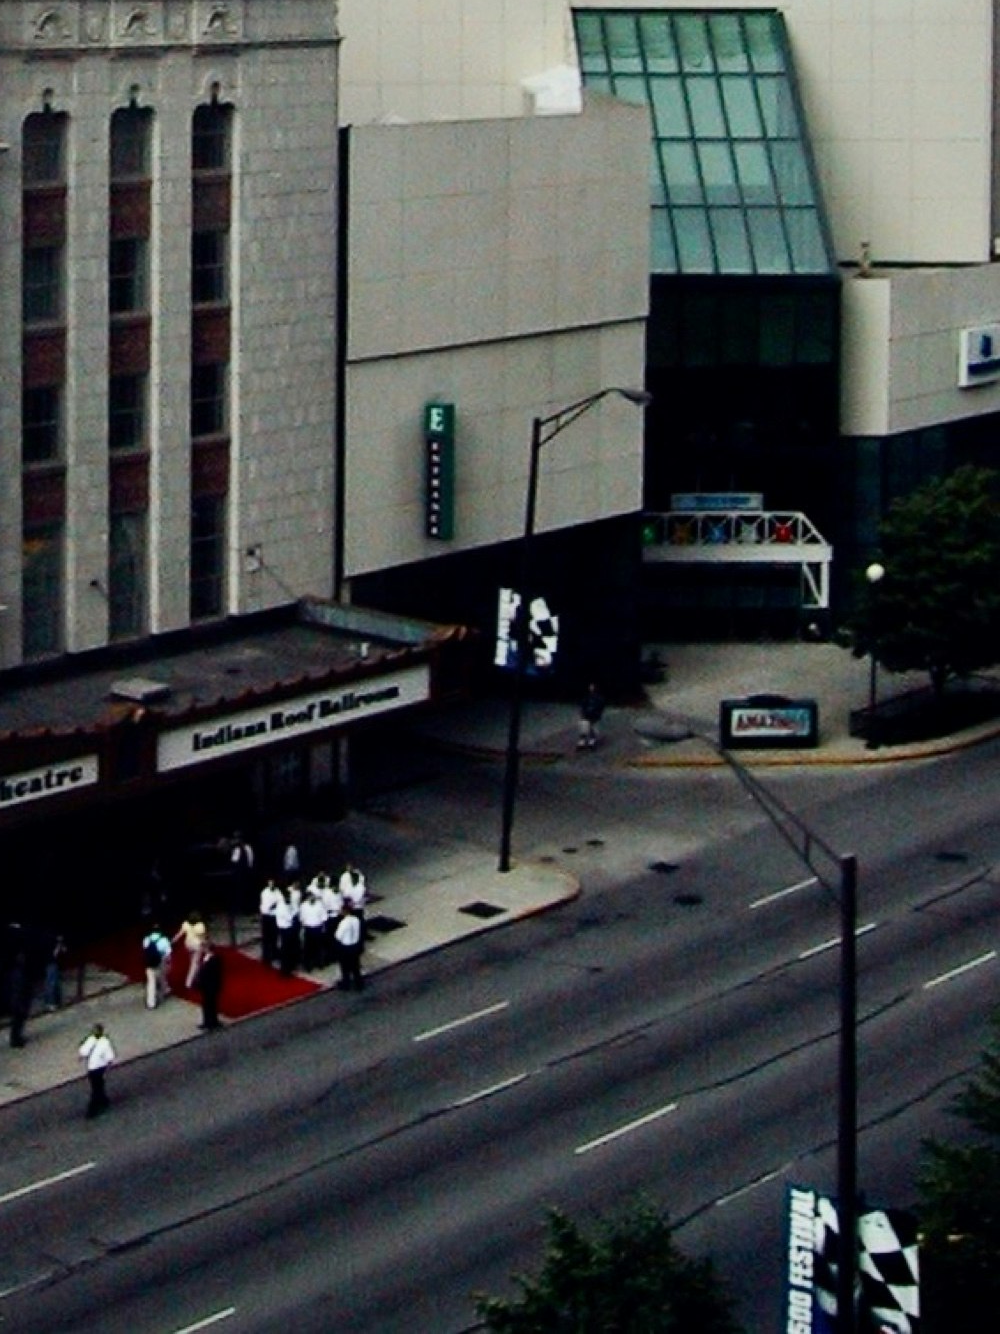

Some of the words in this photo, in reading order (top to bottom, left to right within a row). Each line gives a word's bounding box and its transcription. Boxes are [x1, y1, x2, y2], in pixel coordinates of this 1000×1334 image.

[430, 407, 444, 432] E
[193, 721, 267, 751] Indiana
[270, 704, 316, 731] Roof
[789, 1188, 815, 1289] FESTIVAL
